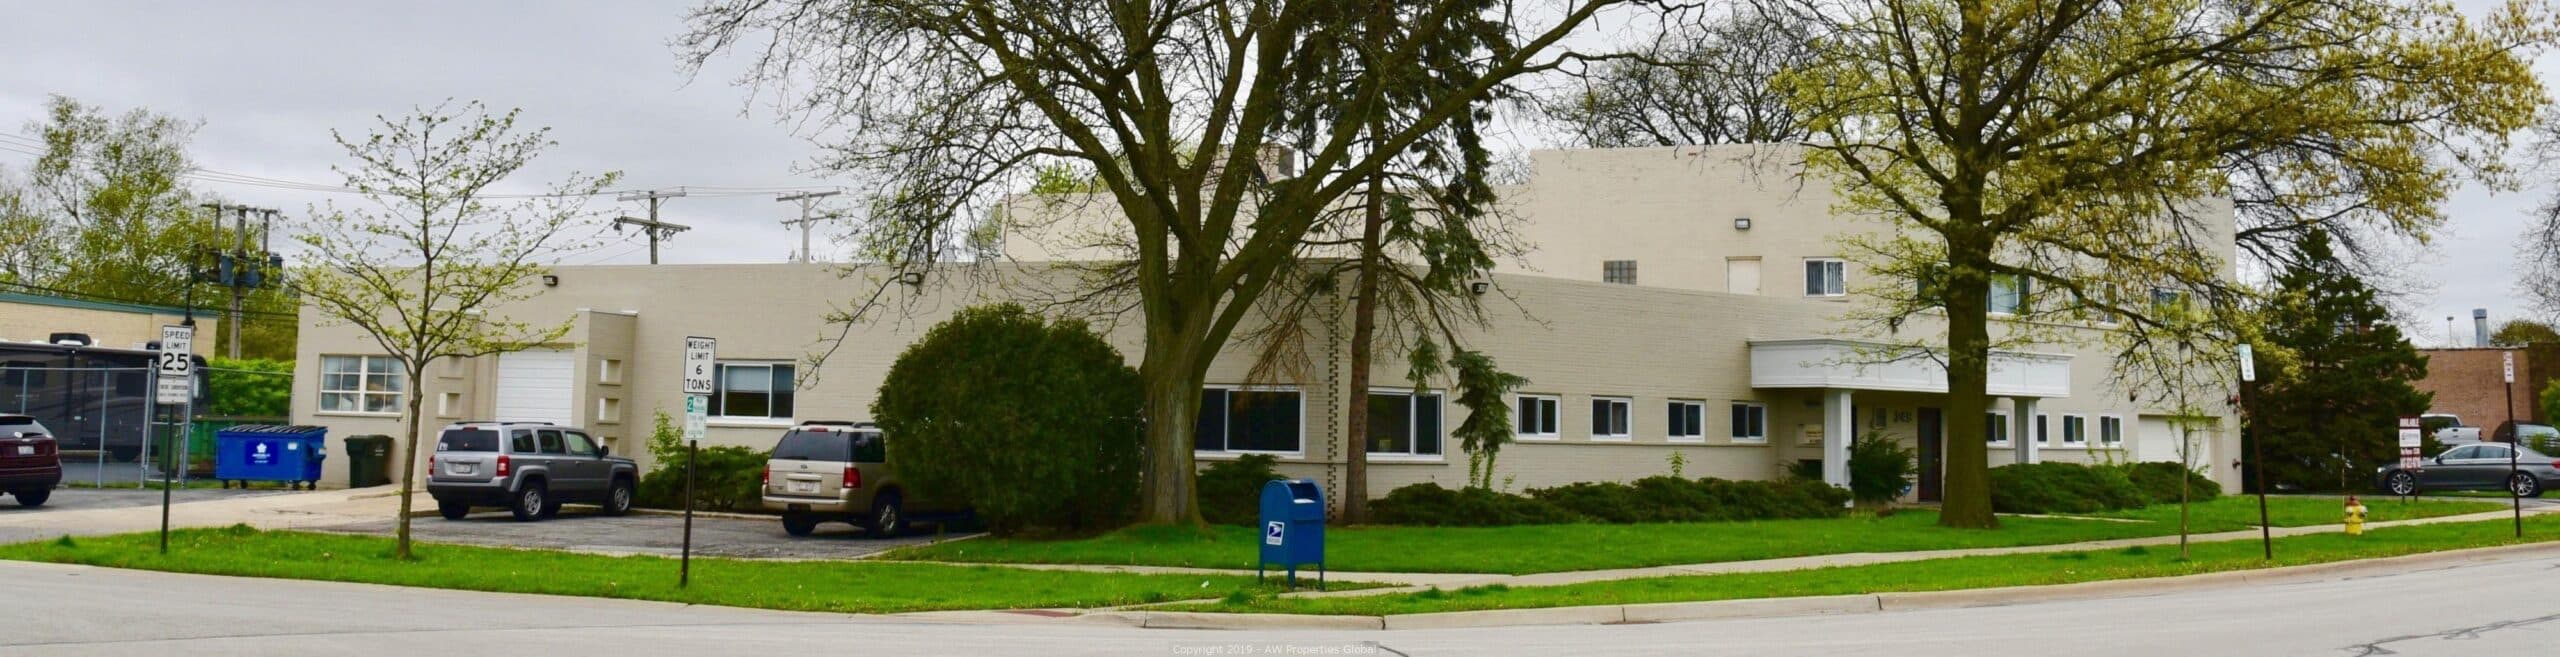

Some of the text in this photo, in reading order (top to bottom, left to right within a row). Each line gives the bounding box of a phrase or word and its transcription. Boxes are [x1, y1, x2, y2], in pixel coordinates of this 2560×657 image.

[164, 330, 190, 340] SPEED
[688, 341, 714, 349] WEIGHT
[690, 352, 709, 360] LIMIT
[163, 352, 188, 371] 25
[695, 364, 703, 375] 6
[686, 378, 711, 390] TONS
